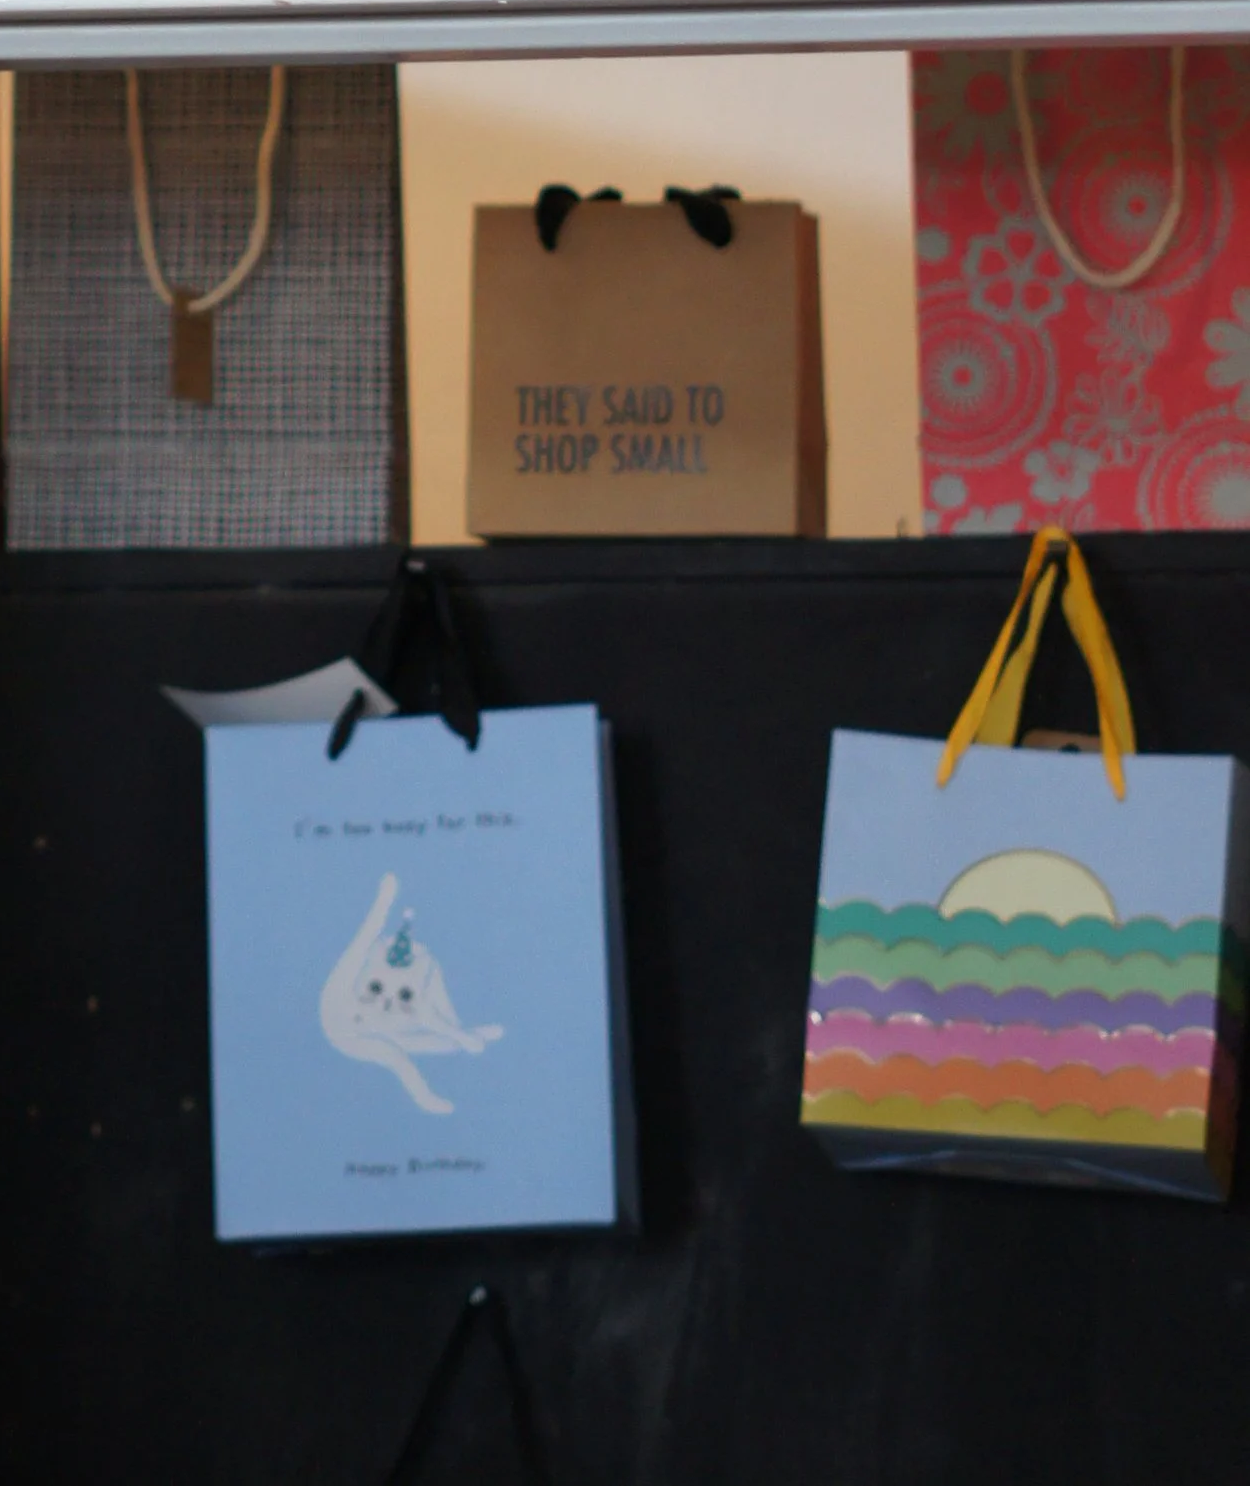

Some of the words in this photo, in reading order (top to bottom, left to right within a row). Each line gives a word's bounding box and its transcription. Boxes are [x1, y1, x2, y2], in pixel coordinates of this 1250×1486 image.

[515, 385, 593, 427] THEY
[602, 384, 674, 426] SAID
[685, 385, 726, 428] TO
[514, 432, 600, 475] SHOP
[609, 432, 709, 475] SMALL
